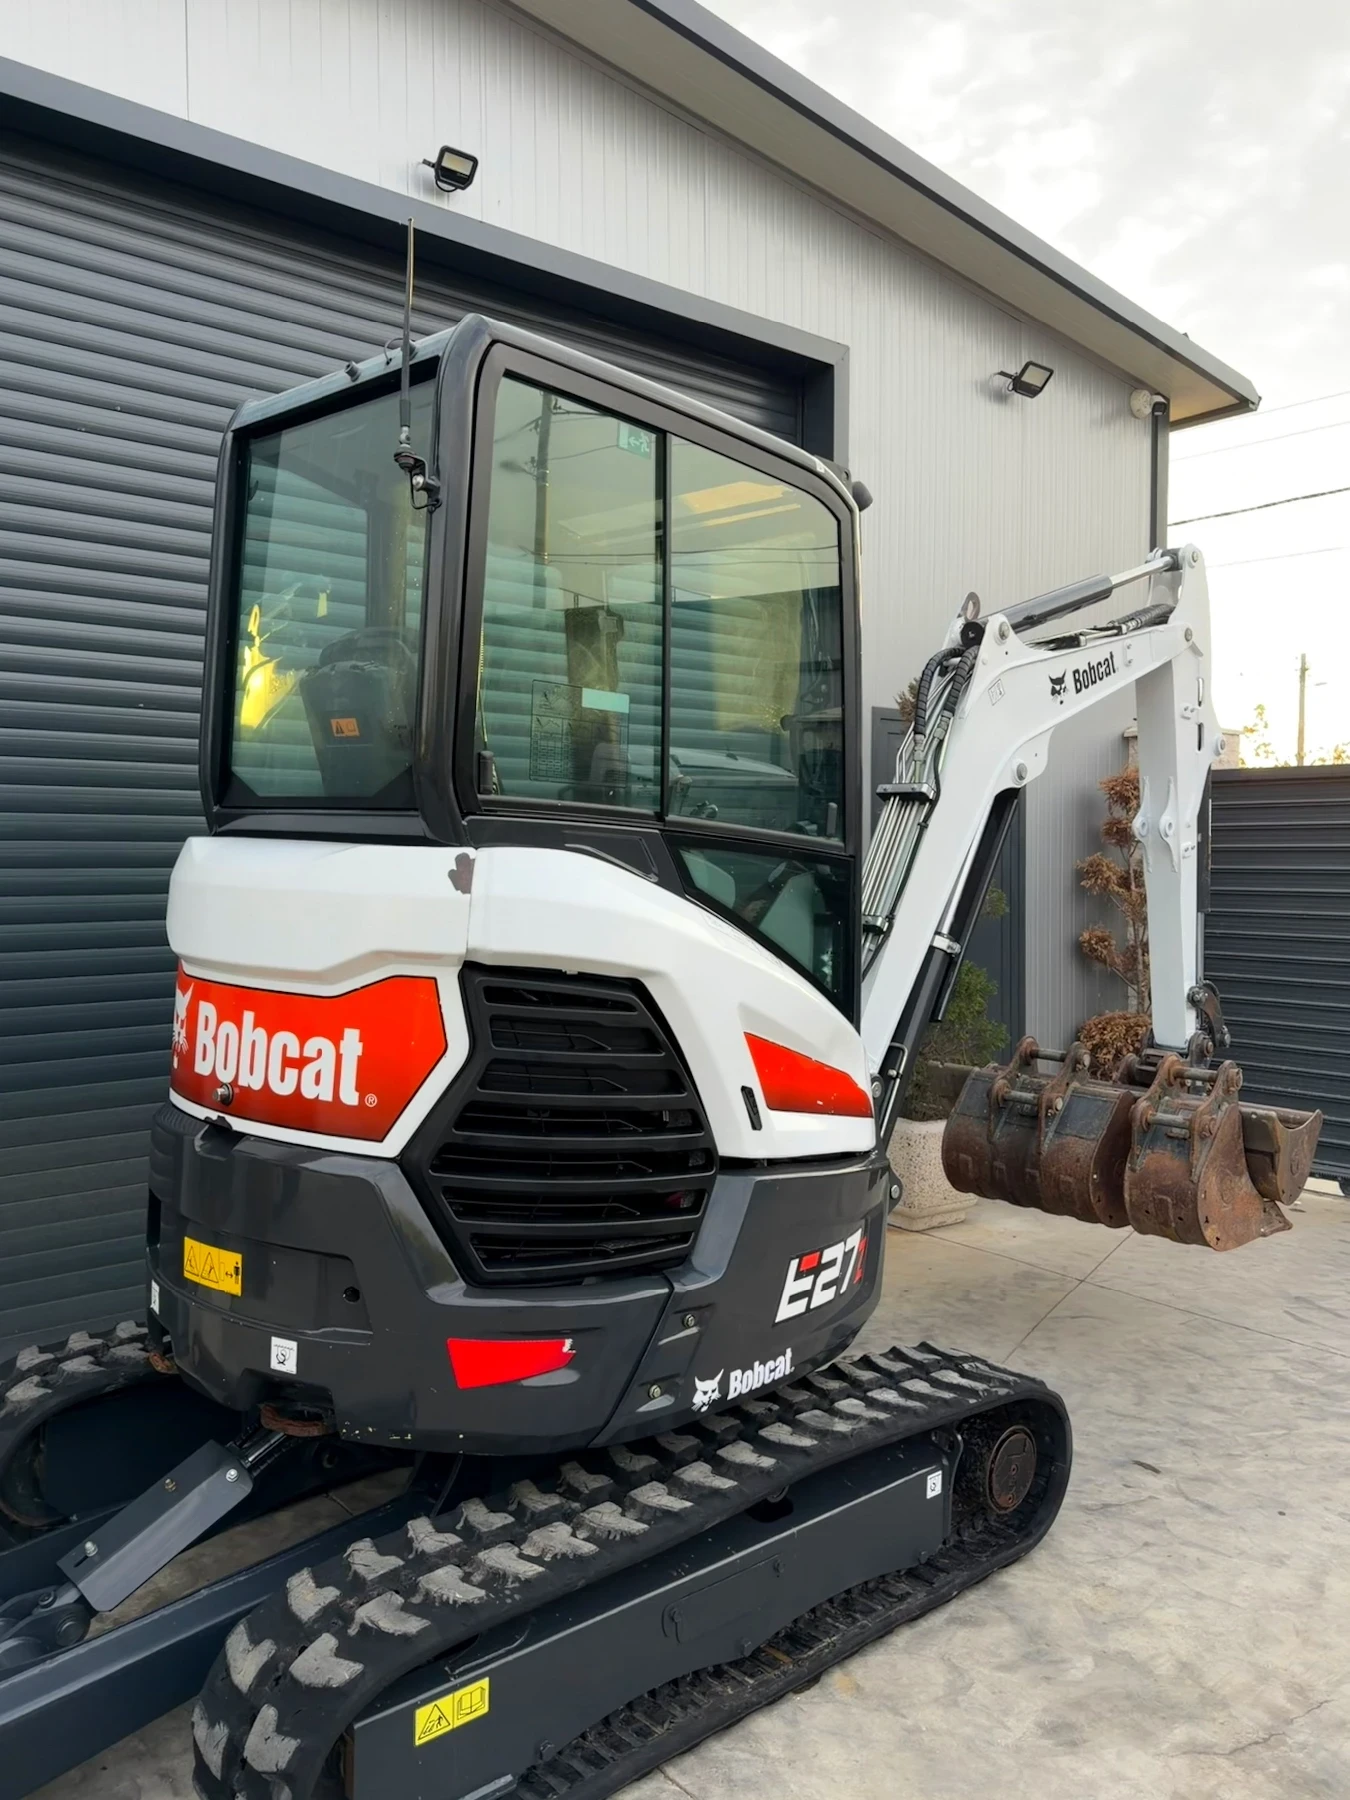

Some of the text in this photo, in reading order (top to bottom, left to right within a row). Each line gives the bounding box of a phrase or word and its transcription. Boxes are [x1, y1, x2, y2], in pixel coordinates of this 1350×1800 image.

[1072, 651, 1116, 695] Bobcat
[194, 1000, 364, 1106] Bobcat
[727, 1347, 793, 1400] Bobcat
